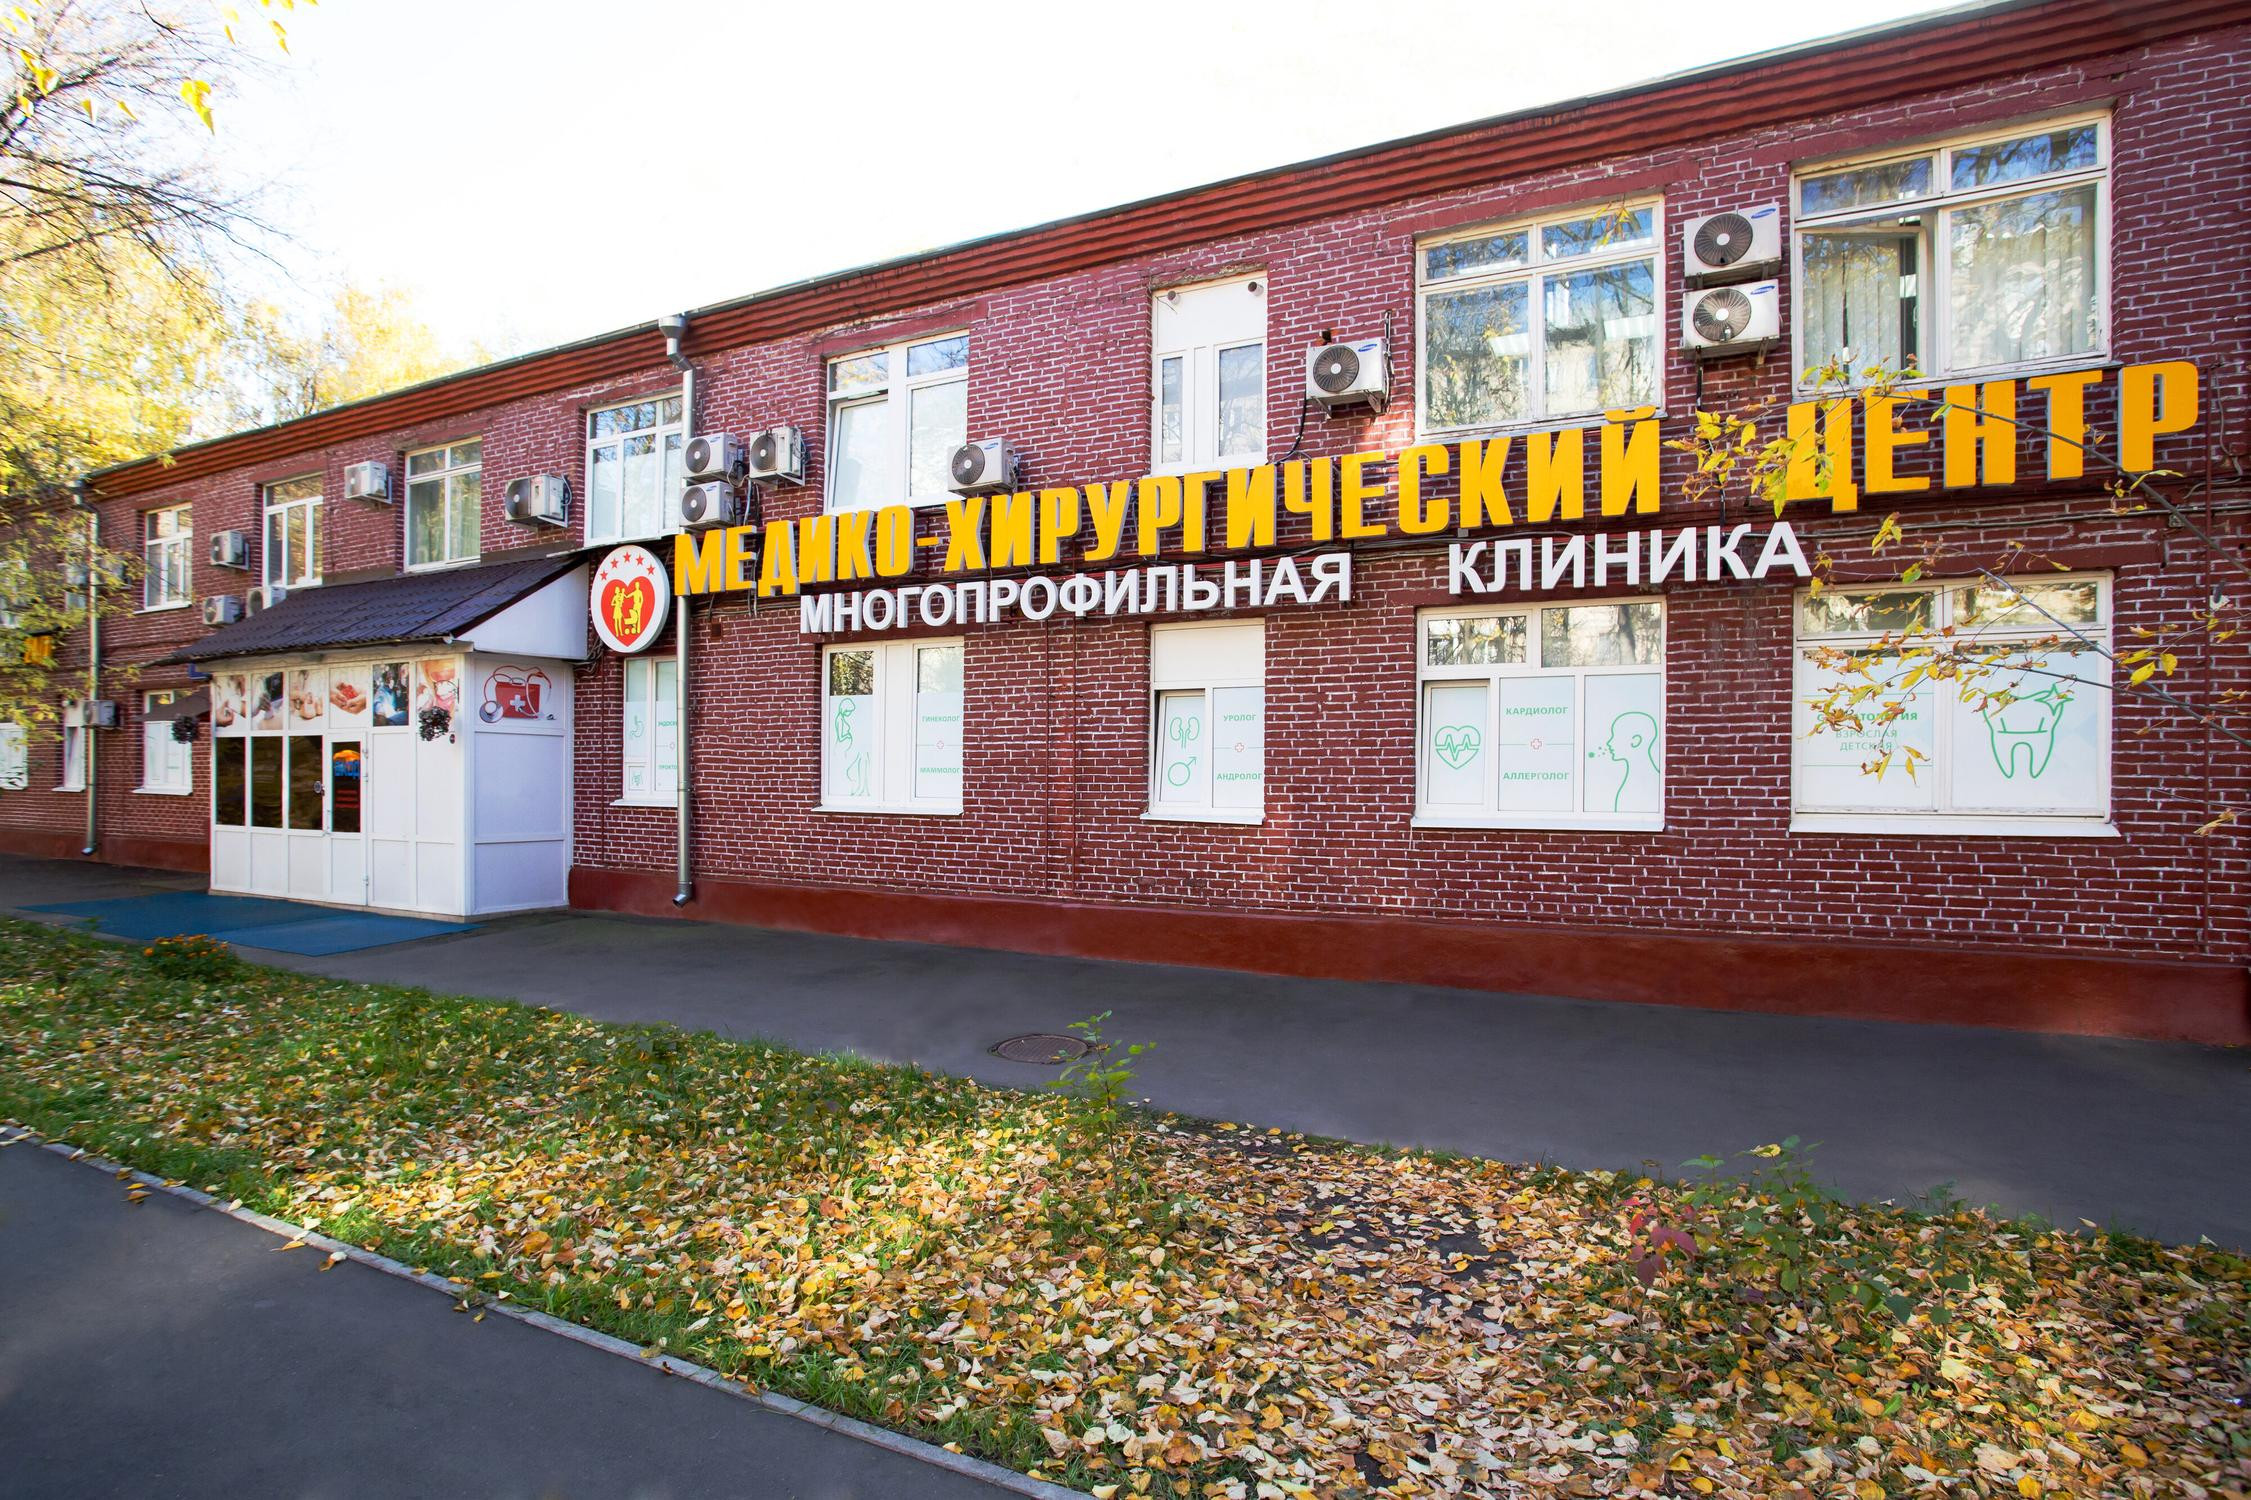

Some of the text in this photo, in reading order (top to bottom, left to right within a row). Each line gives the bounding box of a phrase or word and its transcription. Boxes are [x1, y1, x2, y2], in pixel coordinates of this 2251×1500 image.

[674, 361, 2199, 597] МЕДИКО-ХИРУРГИЧЕСКИЙ ЦЕНТР
[800, 521, 1813, 634] МНОГОПРОФИЛЬНАЯ КЛИНИКА
[1505, 706, 1568, 716] КАРДИОЛОГ
[921, 715, 960, 723] ГИНЕКОЛОГ
[1223, 714, 1257, 722] УРОЛОГ
[1216, 773, 1263, 781] АНДРОЛОГ
[1503, 772, 1569, 780] АЛЛЕРГОЛОГ
